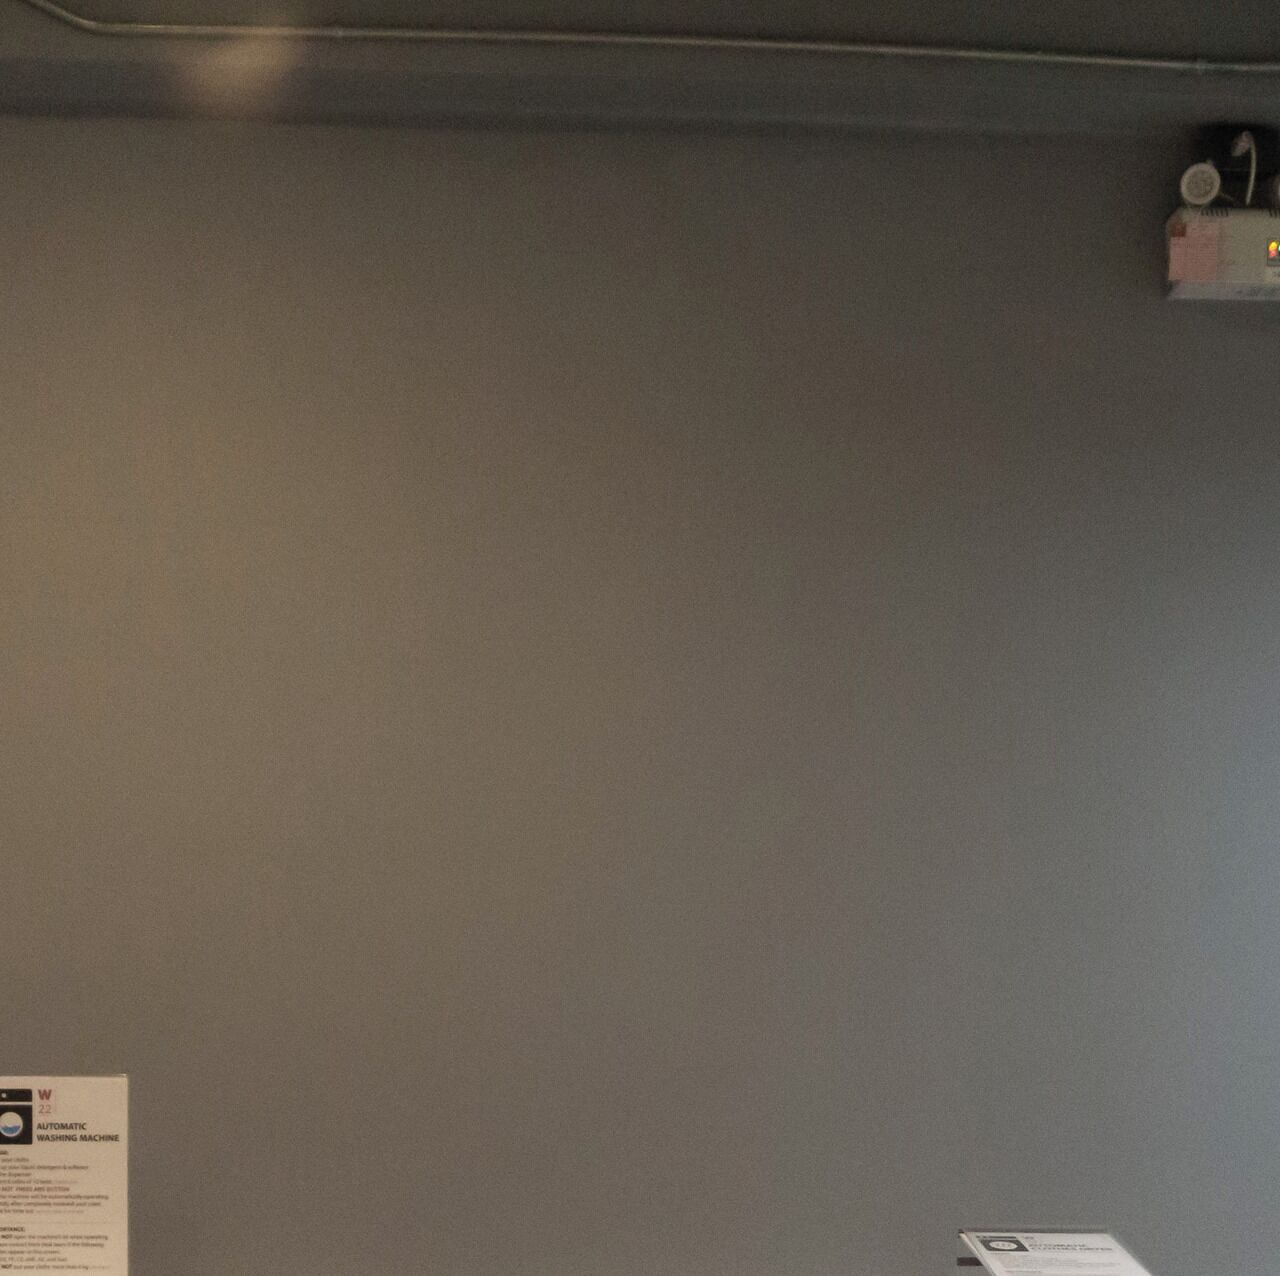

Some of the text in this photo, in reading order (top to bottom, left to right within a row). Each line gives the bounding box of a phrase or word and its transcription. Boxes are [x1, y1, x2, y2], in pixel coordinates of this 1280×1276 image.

[38, 1089, 52, 1100] W
[38, 1104, 52, 1114] 22
[37, 1122, 87, 1130] AUTOMATIC
[37, 1134, 120, 1142] WASHING MACHINE
